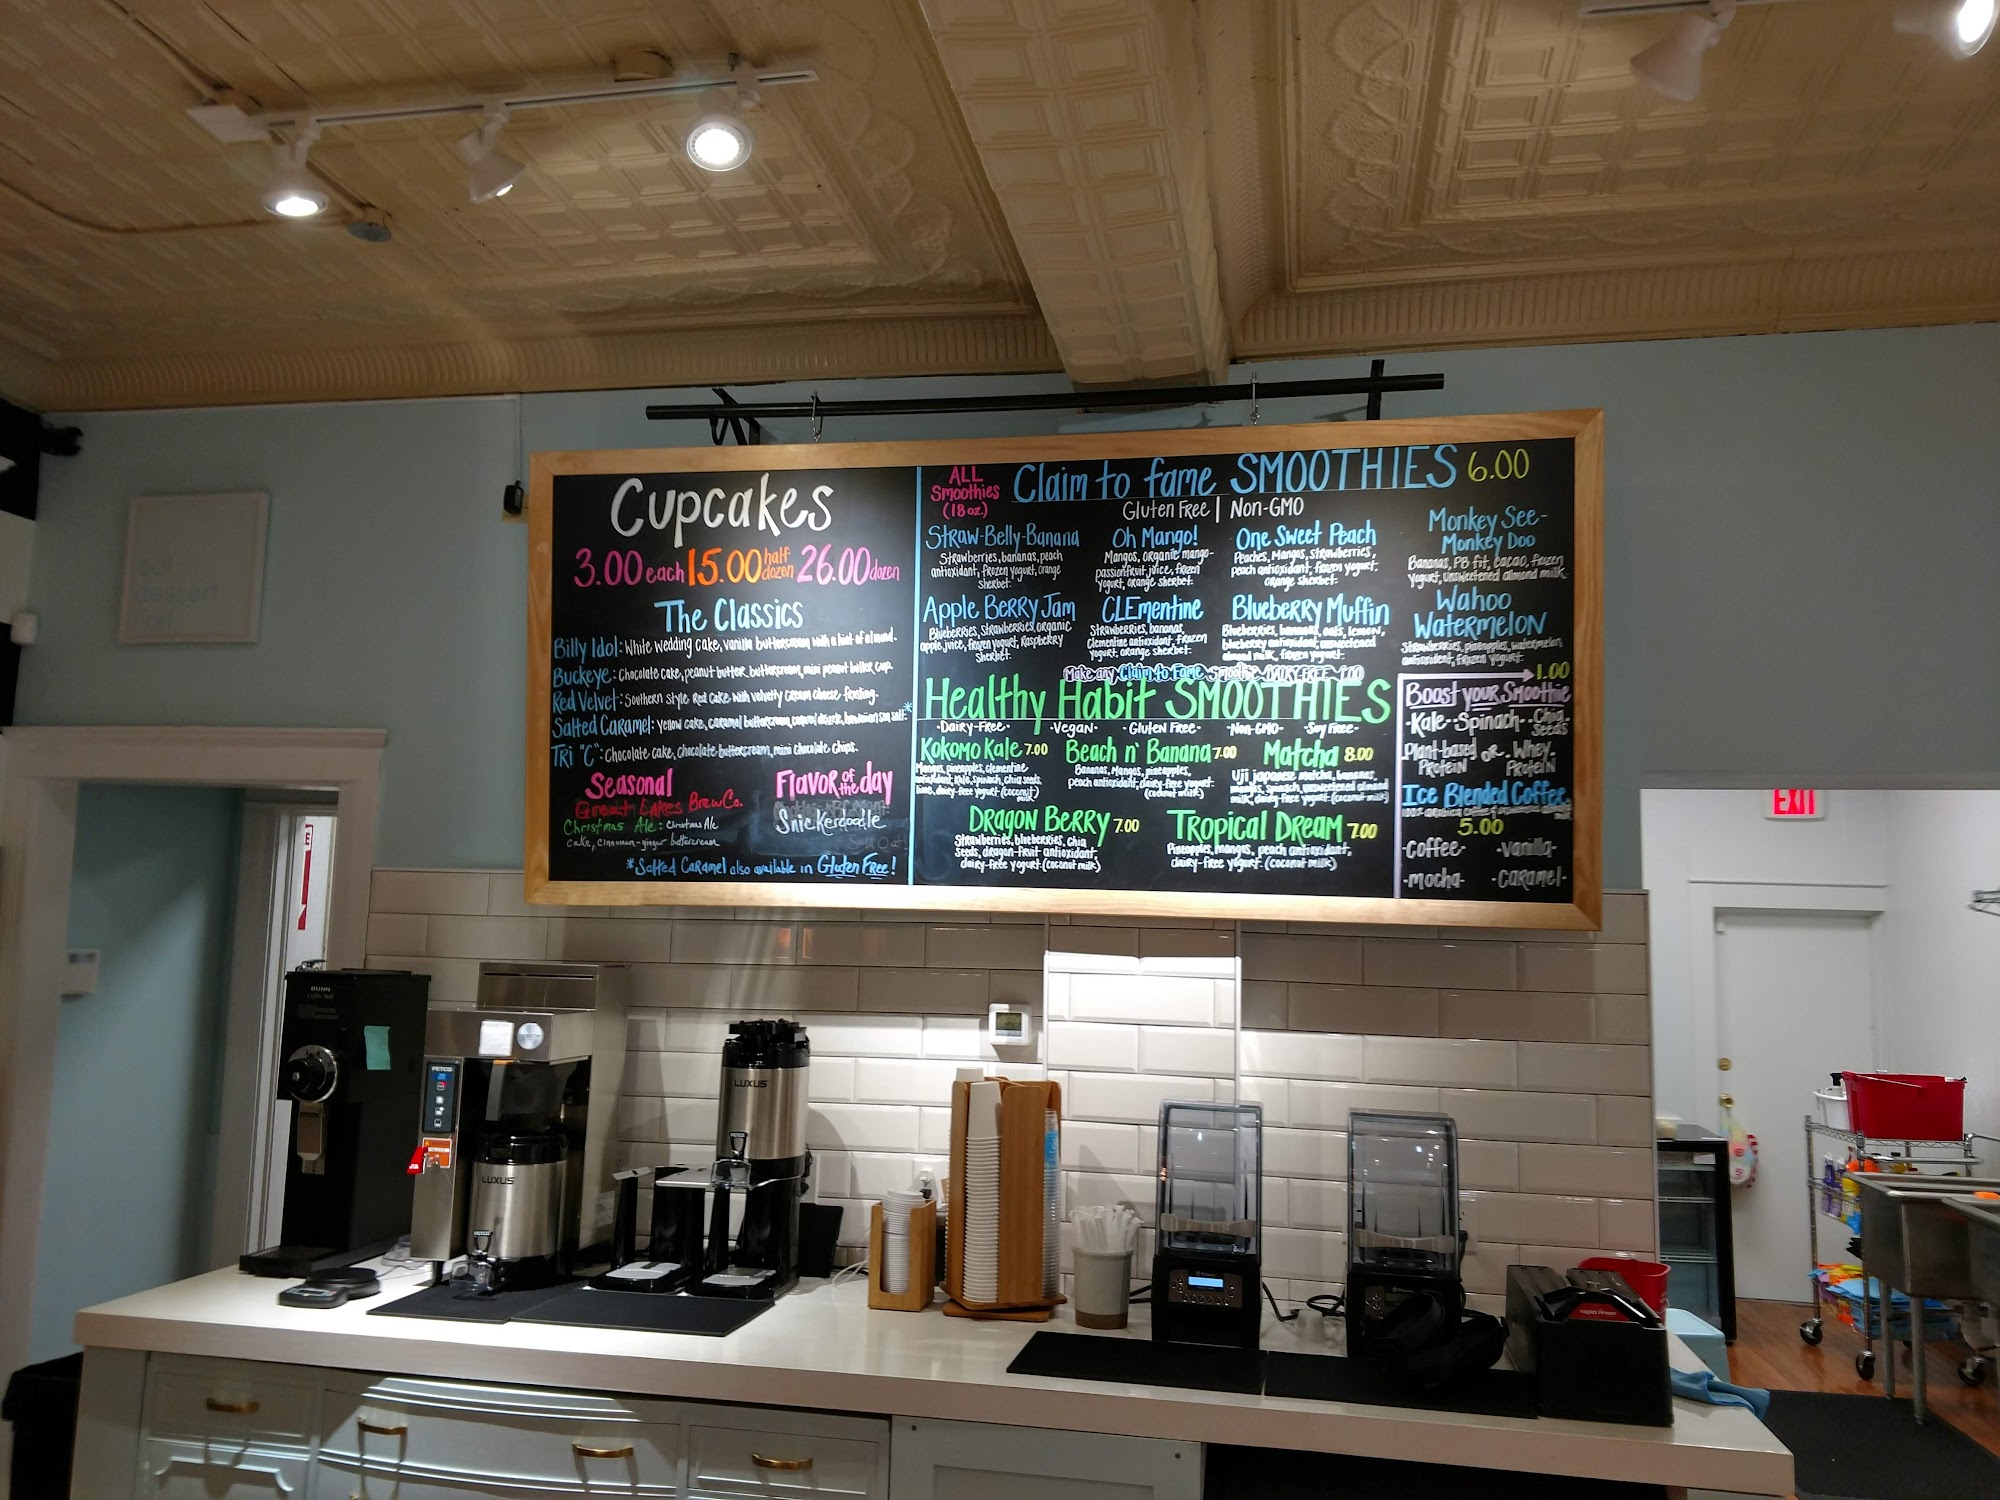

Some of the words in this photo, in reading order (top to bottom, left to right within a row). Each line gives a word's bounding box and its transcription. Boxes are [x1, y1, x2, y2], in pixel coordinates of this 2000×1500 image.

[949, 466, 983, 484] ALL
[1013, 463, 1088, 503] Claim
[1095, 460, 1131, 499] to
[1143, 457, 1217, 497] fame
[1230, 444, 1458, 495] SMOOTHIES
[1468, 448, 1529, 483] 6.00
[930, 483, 1000, 502] Smoothies
[610, 472, 834, 548] Cupcakes
[1123, 500, 1174, 521] Gluten
[1178, 500, 1210, 518] Free
[1229, 497, 1304, 519] Non-GMO
[1428, 506, 1498, 537] Monkey
[1113, 526, 1136, 548] Oh
[1142, 525, 1198, 552] Mango!
[1236, 528, 1271, 551] One
[1274, 520, 1322, 547] Sweet
[1329, 520, 1376, 546] Peach
[1441, 533, 1504, 557] Monkey
[1508, 532, 1536, 549] Doo
[688, 548, 762, 587] 15.00
[764, 546, 791, 565] half
[797, 544, 871, 586] 26.00
[939, 550, 1001, 565] Strawberries,
[1001, 550, 1039, 562] bananas,
[1040, 550, 1063, 564] peach
[1143, 548, 1180, 562] organic
[1454, 556, 1470, 569] PB
[574, 548, 642, 588] 3.00
[646, 562, 685, 583] each
[761, 563, 794, 580] dozen
[869, 560, 900, 581] dozen
[931, 564, 980, 578] antioxidant,
[981, 565, 1009, 577] frozen
[1038, 565, 1061, 580] orange
[1175, 562, 1200, 575] frozen
[1231, 565, 1256, 578] peach
[1127, 578, 1156, 592] orange
[923, 594, 980, 628] Apple
[985, 594, 1038, 629] Berry
[1041, 592, 1076, 621] Jam
[1102, 595, 1204, 624] CLEmentine
[1232, 594, 1322, 627] Blueberry
[1327, 593, 1389, 626] Muffin
[1436, 585, 1512, 612] Wahoo
[654, 599, 707, 633] The
[714, 598, 803, 631] Classics
[1036, 619, 1072, 636] organic
[1413, 611, 1547, 641] Watermelon
[554, 637, 586, 664] Billy
[592, 635, 623, 657] Idol:
[625, 639, 652, 656] White
[655, 637, 692, 659] wedding
[695, 636, 723, 652] cake,
[724, 637, 753, 651] vanilla
[920, 639, 943, 654] apple
[1175, 633, 1207, 644] frozen
[1120, 648, 1151, 660] orange
[553, 665, 617, 690] Buckeye:
[618, 666, 659, 681] Chocolate
[660, 667, 684, 682] cake,
[685, 665, 715, 684] peanut
[716, 665, 749, 679] butter
[1065, 667, 1095, 680] Make
[1096, 668, 1114, 684] any
[1120, 665, 1152, 680] Claim
[1155, 665, 1168, 679] to
[1173, 666, 1204, 679] Fame
[1536, 661, 1570, 680] 1.00
[552, 691, 576, 714] Red
[578, 688, 623, 712] Velvet:
[625, 692, 663, 708] Southern
[666, 692, 689, 710] style
[693, 693, 707, 706] Red
[925, 673, 1046, 735] Healthy
[1058, 677, 1156, 720] Habit
[1165, 677, 1391, 724] SMOOTHIES
[1406, 681, 1461, 707] Boost
[1462, 685, 1502, 711] your
[1501, 681, 1572, 704] Smoothie
[552, 714, 597, 738] Salted
[601, 714, 655, 737] Caramel:
[657, 719, 681, 734] yellow
[684, 717, 708, 731] cake,
[1129, 721, 1167, 734] Gluten
[551, 744, 573, 768] Tri
[605, 746, 650, 763] Chocolate
[652, 745, 677, 760] cake,
[677, 743, 718, 759] chocolate
[921, 736, 980, 764] Kokomo
[984, 736, 1023, 761] Kale
[1024, 743, 1048, 755] 7.00
[1066, 736, 1118, 764] Beach
[1146, 738, 1211, 764] Banana
[1212, 746, 1237, 759] 7.00
[1263, 738, 1339, 771] Matcha
[1344, 747, 1374, 762] 8.00
[585, 768, 673, 799] Seasonal
[776, 770, 840, 799] Flavor
[842, 768, 855, 783] of
[860, 761, 893, 806] day
[838, 783, 859, 796] the
[1402, 784, 1438, 806] Ice
[1444, 780, 1508, 808] Blended
[1511, 780, 1571, 806] Coffee
[575, 801, 634, 819] Great
[639, 799, 682, 816] Lakes
[564, 818, 624, 835] Christmas
[666, 817, 702, 830] Christmas
[704, 816, 718, 829] Ale
[776, 809, 886, 836] Snickerdoodle
[969, 805, 1038, 839] Dragon
[1044, 805, 1111, 847] Berry
[1113, 819, 1140, 833] 7.00
[1167, 810, 1267, 847] Tropical
[1275, 811, 1343, 847] Dream
[1347, 823, 1377, 839] 7.00
[1457, 818, 1504, 835] 5.00
[567, 835, 594, 852] cake,
[670, 832, 720, 846] buttercream
[681, 856, 727, 875] Caramel
[730, 860, 750, 875] also
[754, 856, 796, 875] available
[801, 866, 813, 874] in
[817, 854, 860, 875] Gluten
[862, 852, 896, 875] Free!
[482, 1177, 515, 1185] LUXUS
